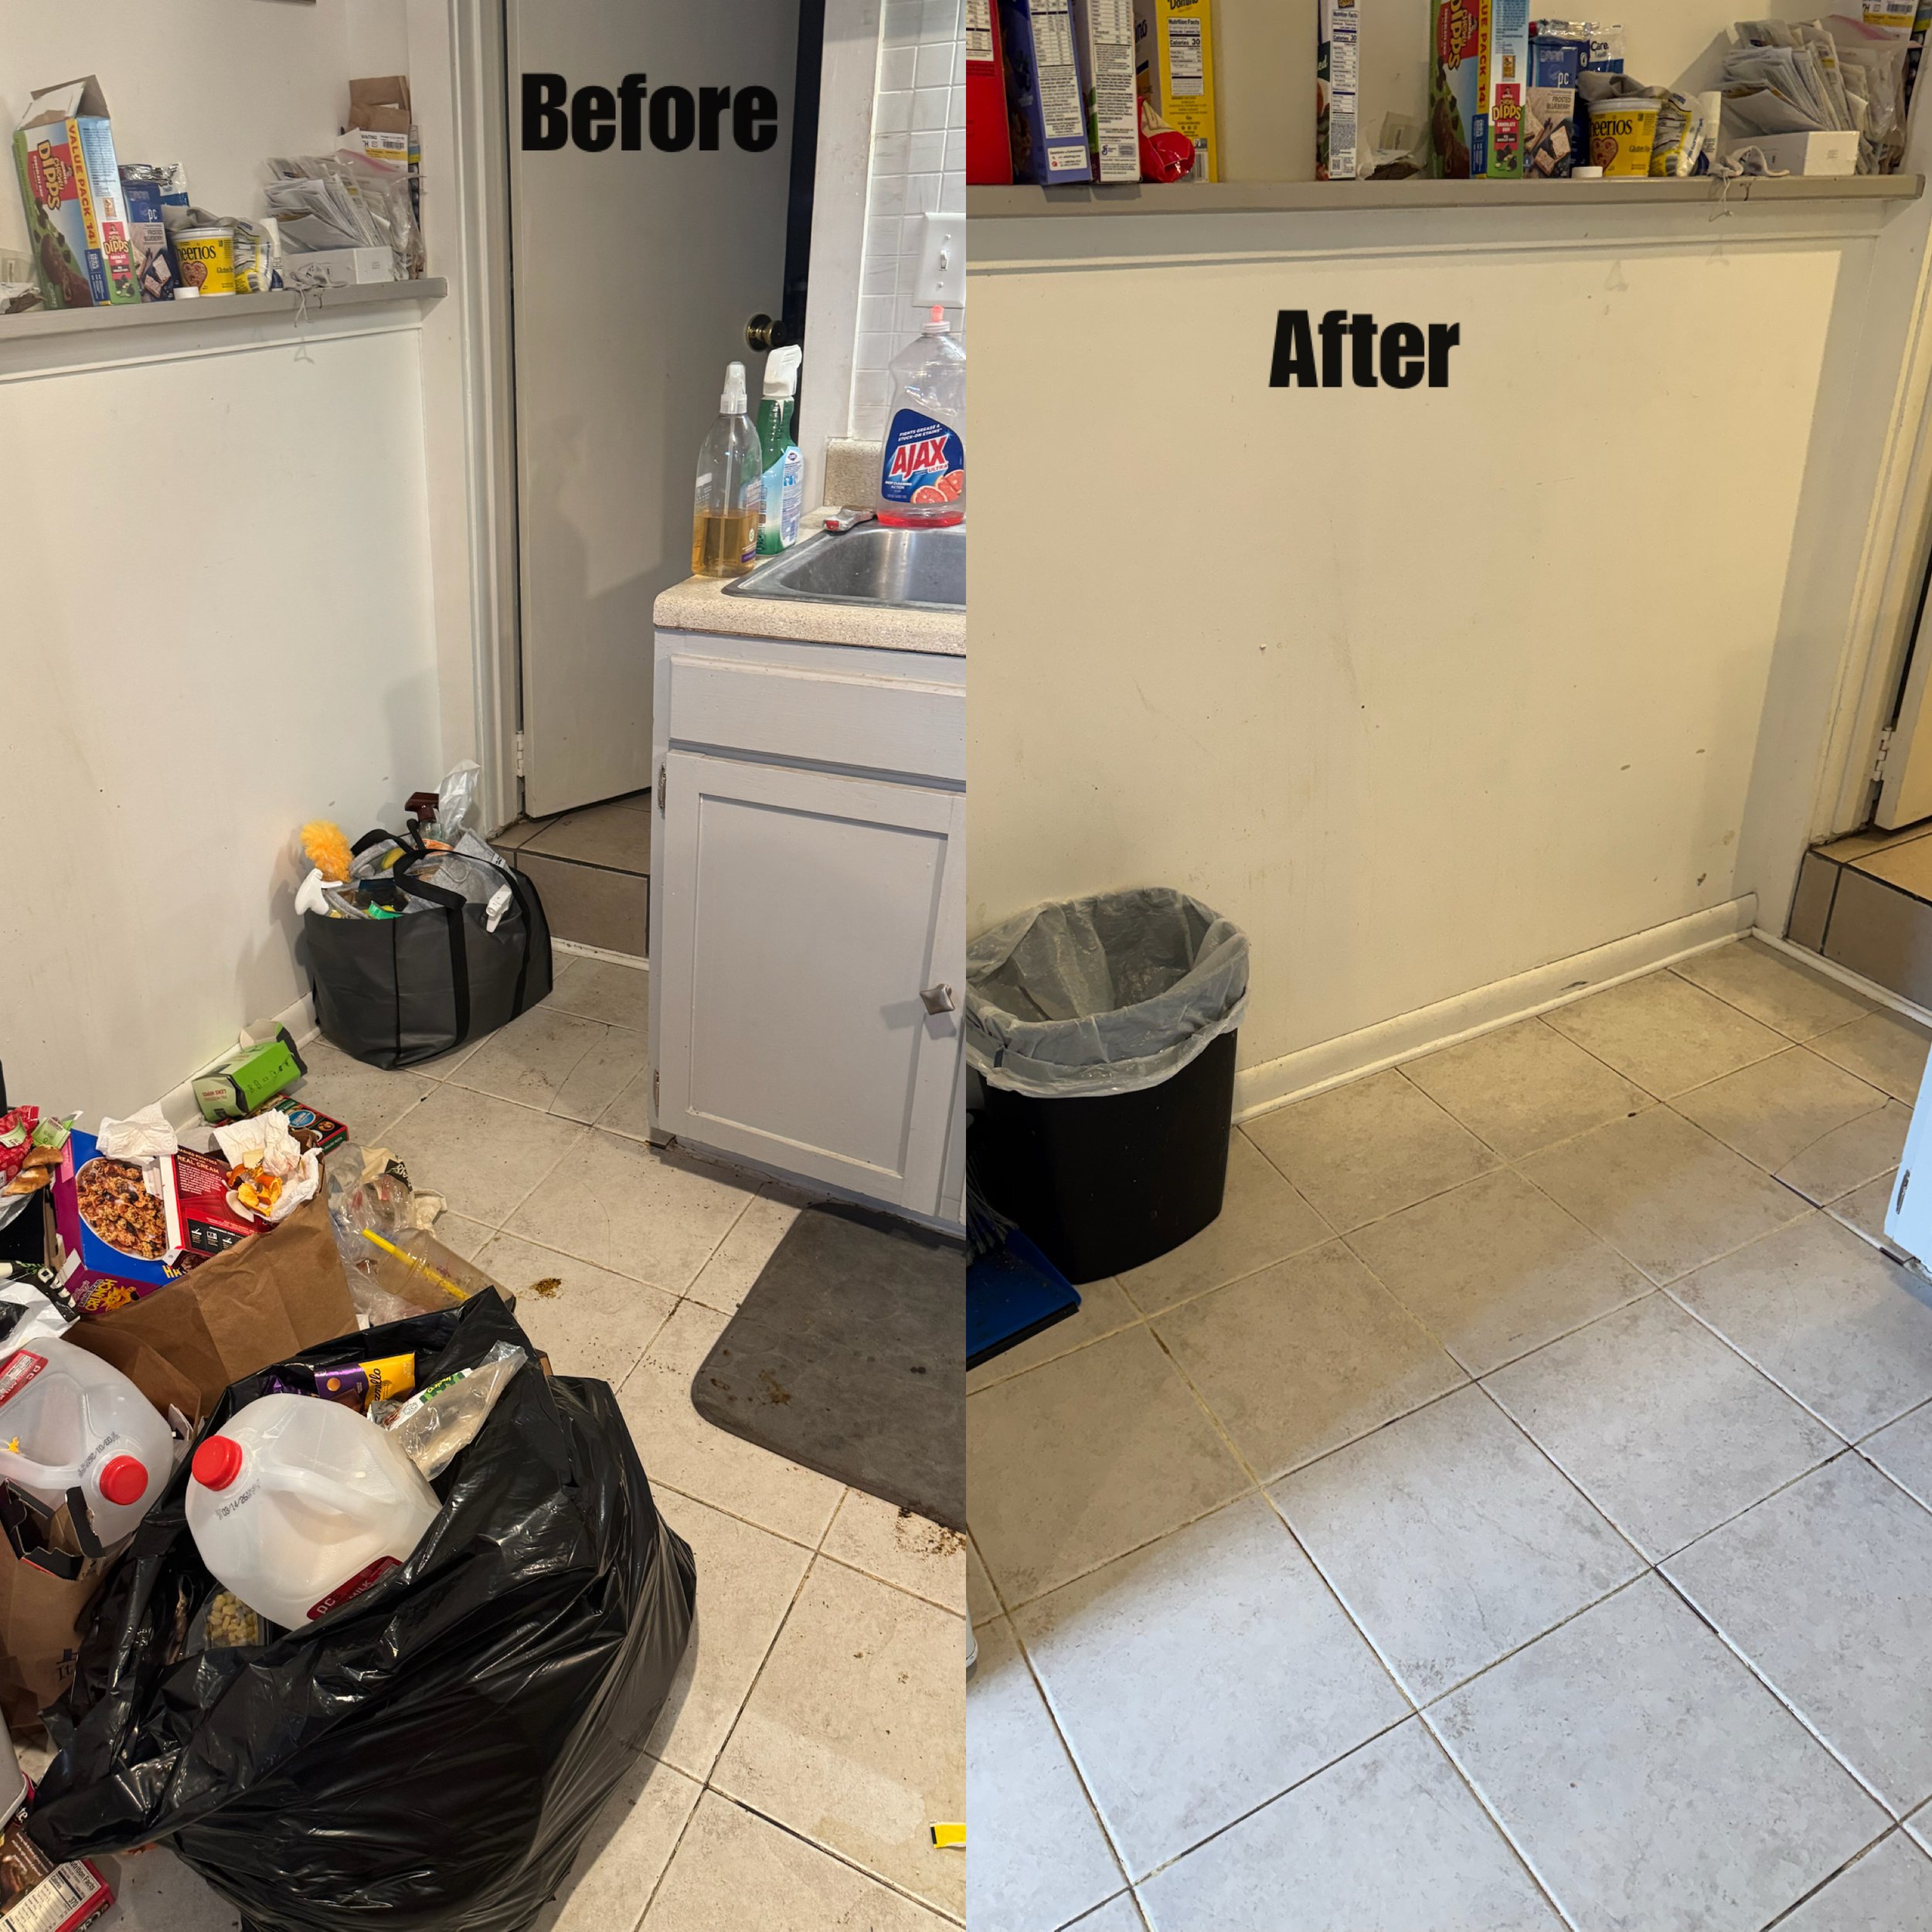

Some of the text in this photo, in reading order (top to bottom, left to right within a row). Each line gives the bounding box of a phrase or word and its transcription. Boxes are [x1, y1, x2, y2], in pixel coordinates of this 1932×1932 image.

[1492, 105, 1522, 121] DIPPS
[1590, 120, 1632, 137] heerios
[37, 139, 61, 211] DIPPS
[68, 124, 83, 174] VALUE
[77, 179, 92, 216] PACK
[104, 240, 130, 255] DIPPS
[177, 245, 216, 261] heerios
[917, 424, 936, 433] GREASE
[897, 432, 921, 442] STUCK-ON
[890, 435, 947, 479] AJAX
[928, 464, 948, 473] ULTRA
[177, 1155, 219, 1174] REAL CREAM
[85, 1278, 118, 1311] CRUNCH
[83, 1873, 97, 1891] Facts
[68, 1896, 79, 1908] 370
